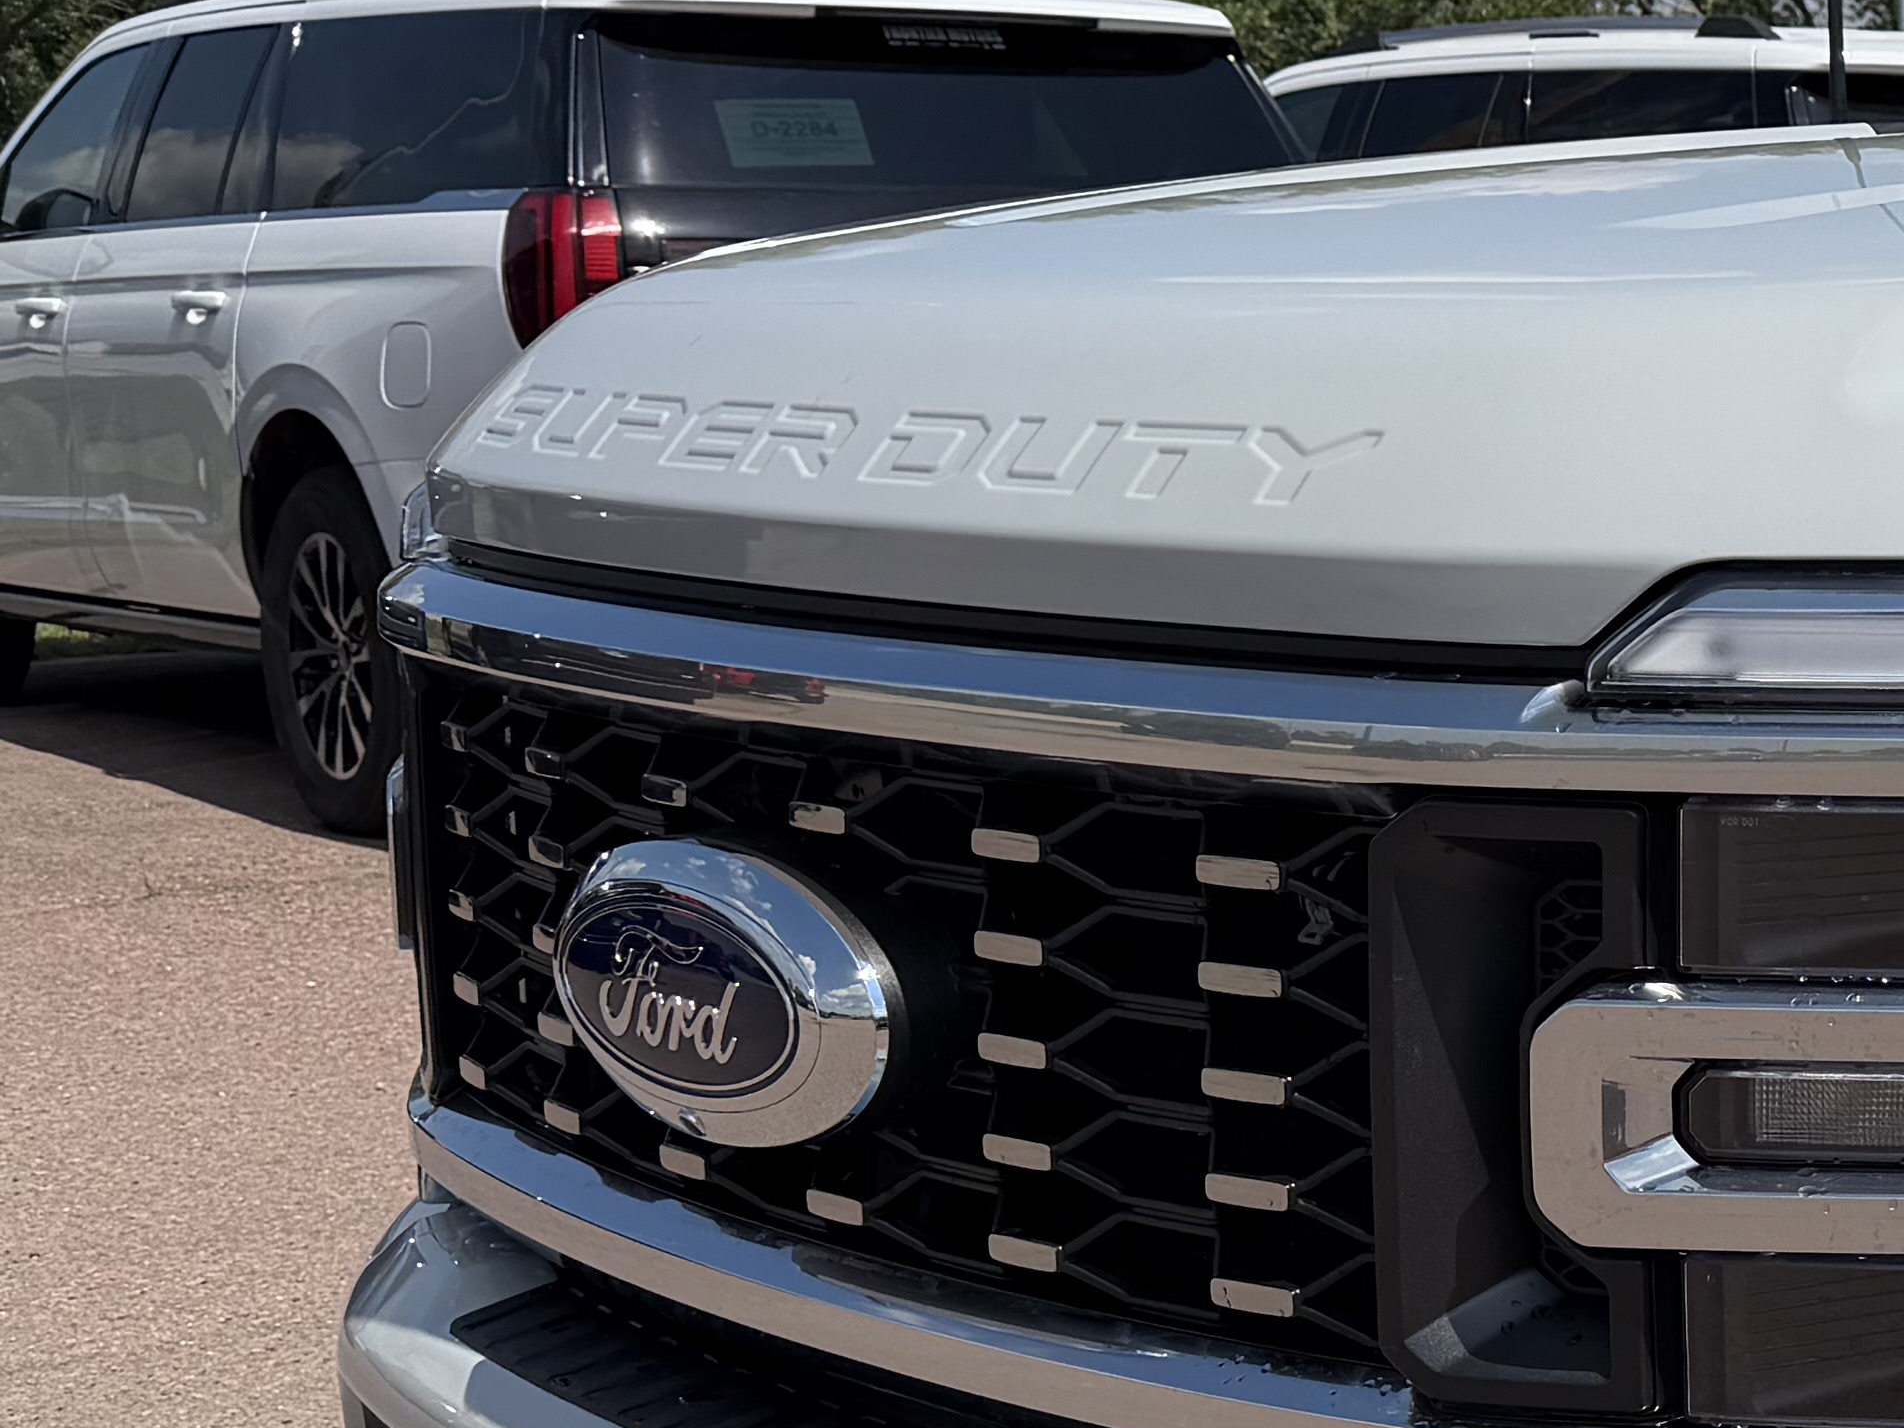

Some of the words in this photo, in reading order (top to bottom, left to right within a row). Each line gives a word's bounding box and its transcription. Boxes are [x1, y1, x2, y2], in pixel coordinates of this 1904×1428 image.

[750, 119, 839, 138] D-2284
[476, 383, 859, 480] SUPER
[855, 410, 1388, 507] DUTY
[599, 923, 740, 1065] Ford
